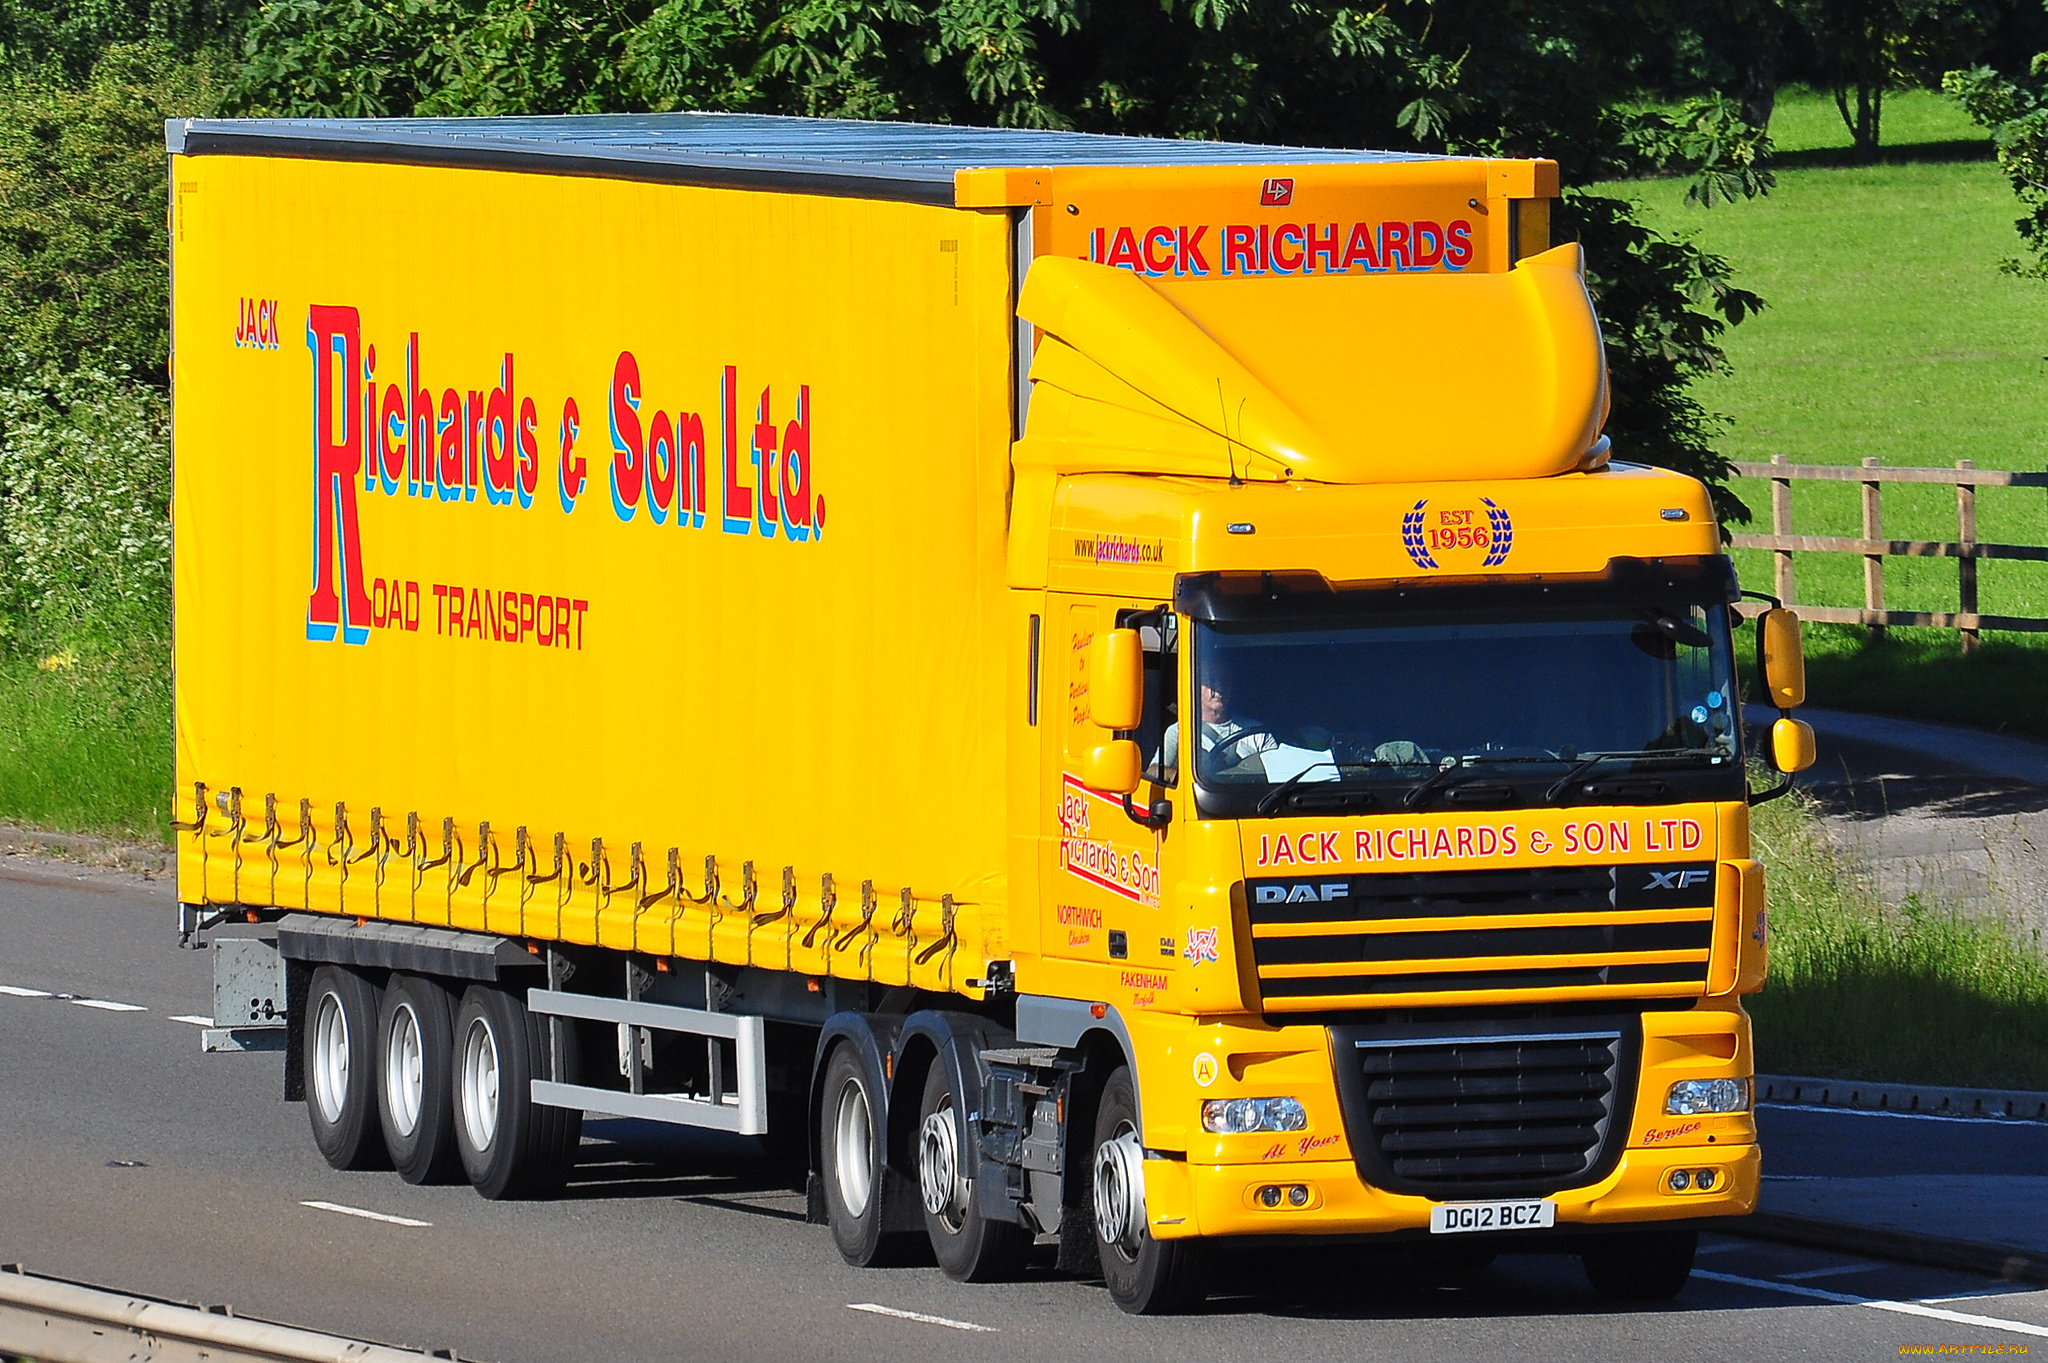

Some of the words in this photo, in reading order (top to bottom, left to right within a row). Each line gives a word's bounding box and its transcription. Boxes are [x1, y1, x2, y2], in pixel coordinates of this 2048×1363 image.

[1079, 226, 1211, 276] JACK
[1222, 220, 1474, 275] RICHARDS
[234, 297, 279, 350] JACK
[306, 304, 538, 645] Richards
[558, 397, 586, 514] &
[608, 350, 705, 527] Son
[722, 365, 826, 542] Ltd.
[1439, 510, 1474, 525] EST
[1074, 532, 1163, 566] www.jackrichards.co.uk
[1428, 527, 1490, 549] 1956
[433, 584, 588, 651] TRANSPORT
[1057, 792, 1090, 829] Jack
[1257, 830, 1341, 866] JACK
[1355, 825, 1518, 863] RICHARDS
[1530, 830, 1554, 854] &
[1563, 821, 1630, 854] SON
[1645, 819, 1703, 852] LTD
[1060, 822, 1117, 878] Richards
[1120, 855, 1129, 883] &
[1132, 851, 1160, 896] Son
[1642, 870, 1710, 890] XF
[1256, 883, 1349, 904] DAF
[1057, 904, 1102, 929] NORTHWICH
[1121, 972, 1167, 991] FAKENHAM
[1643, 1122, 1701, 1145] Service
[1262, 1144, 1287, 1160] At
[1299, 1135, 1340, 1156] Your
[1445, 1208, 1493, 1229] DG12
[1500, 1205, 1541, 1226] BCZ
